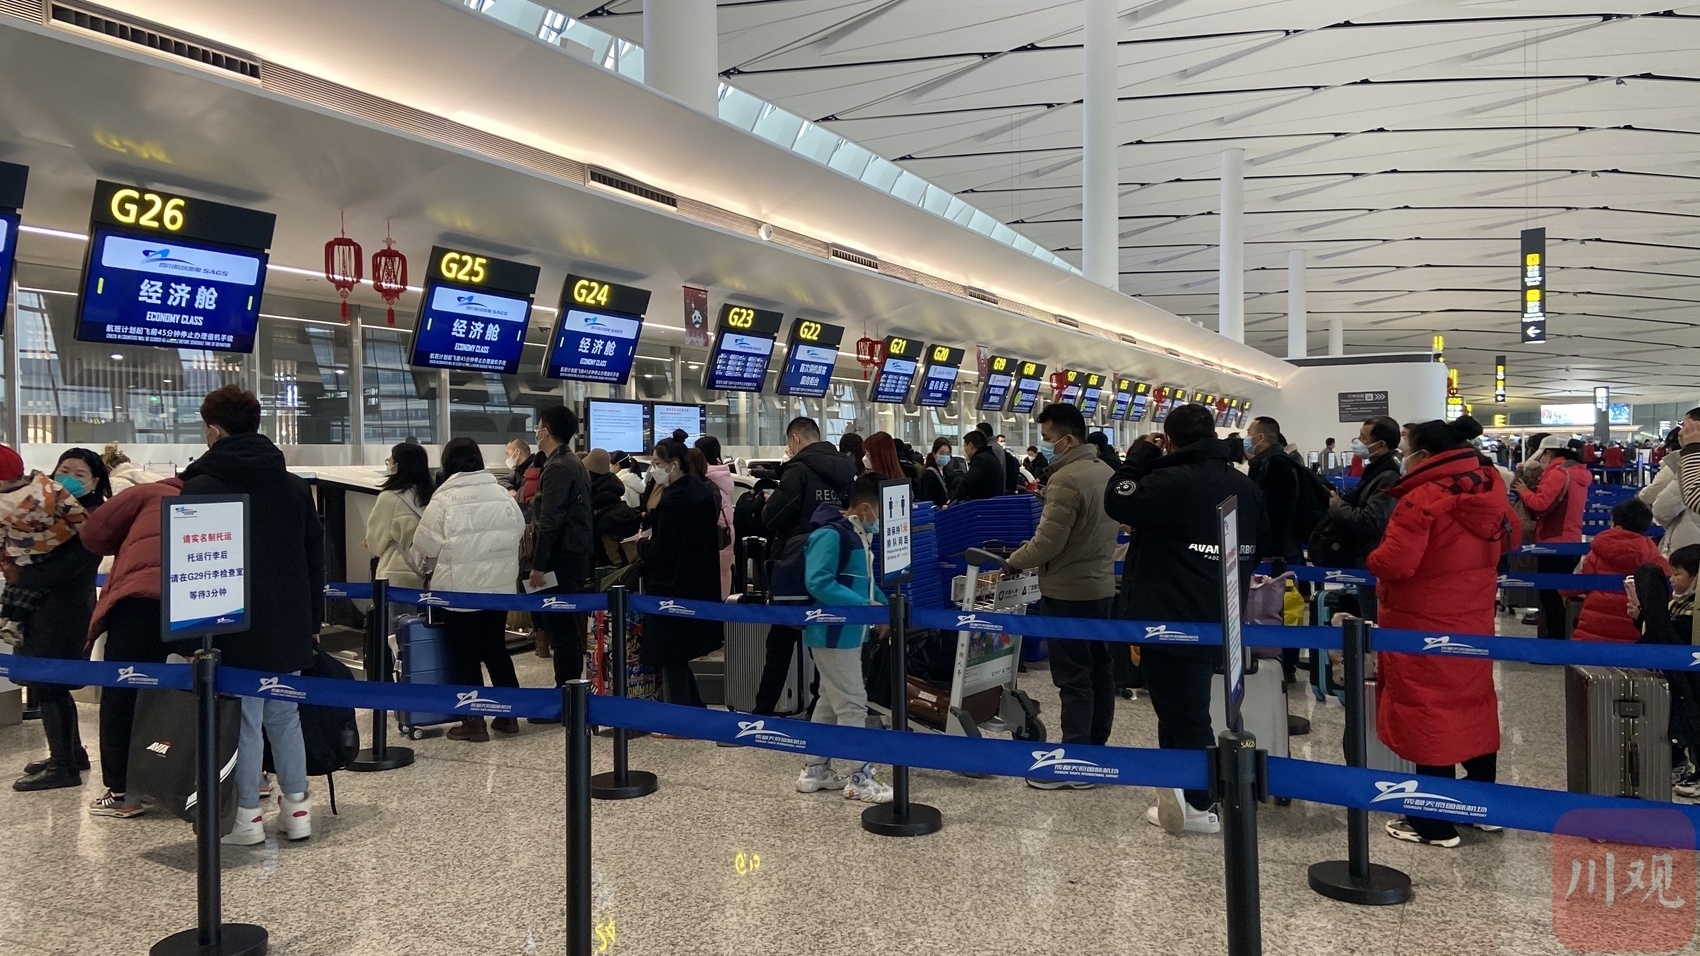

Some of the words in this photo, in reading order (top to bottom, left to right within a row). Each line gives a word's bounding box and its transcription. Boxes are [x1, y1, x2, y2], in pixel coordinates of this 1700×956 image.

[111, 188, 186, 230] G26
[202, 268, 229, 276] SAGS
[441, 252, 487, 282] G25
[138, 278, 218, 310] 经济舱
[574, 280, 609, 306] G24
[146, 311, 180, 324] ECONOMY
[181, 314, 204, 326] CLASS
[729, 307, 754, 327] G23
[451, 318, 500, 341] 经济舱
[800, 321, 821, 340] G22
[578, 337, 616, 356] 经济舱
[890, 338, 907, 354] G21
[934, 347, 949, 361] G20
[993, 358, 1006, 370] G19
[1024, 363, 1036, 375] G18
[183, 532, 232, 544] 请实名制托运
[187, 550, 228, 562] 托运行李后
[171, 567, 244, 583] 请在G29行李检查室
[189, 588, 227, 600] 等待3分钟
[1054, 764, 1119, 774] 成都天府国际机场
[1403, 798, 1487, 813] 成都天府国际机场
